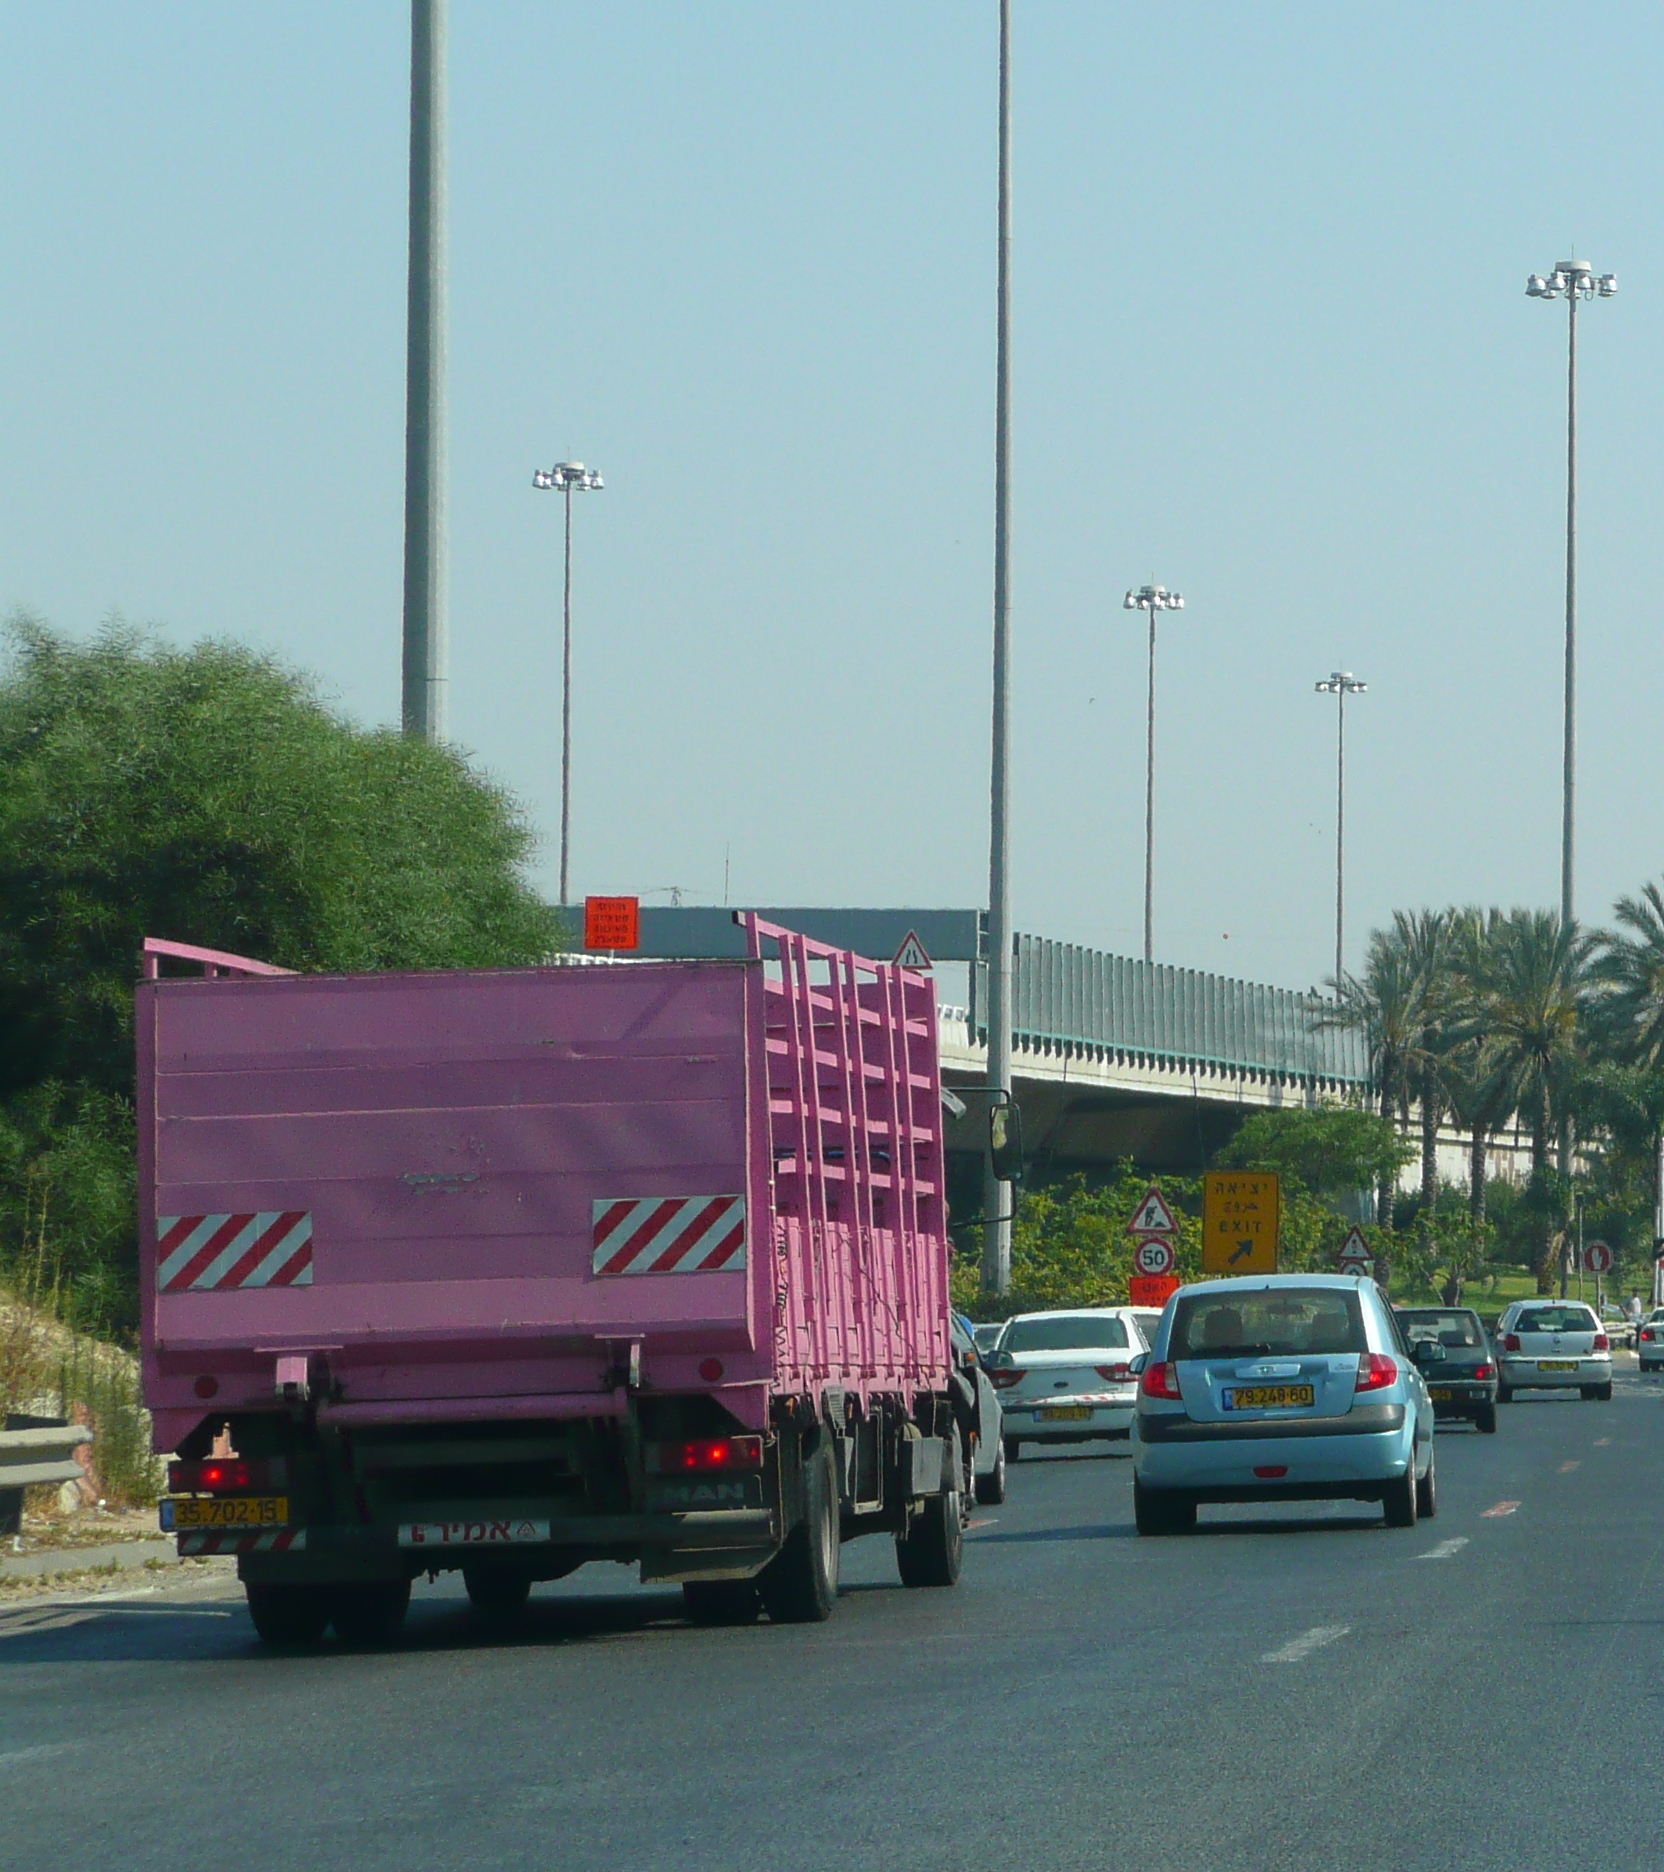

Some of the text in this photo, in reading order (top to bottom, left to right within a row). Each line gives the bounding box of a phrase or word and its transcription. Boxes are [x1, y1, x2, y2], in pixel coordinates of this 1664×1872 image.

[1215, 1182, 1268, 1195] יציאה
[1219, 1220, 1262, 1234] EXIT
[1142, 1250, 1165, 1266] 50
[664, 1483, 745, 1502] MAN
